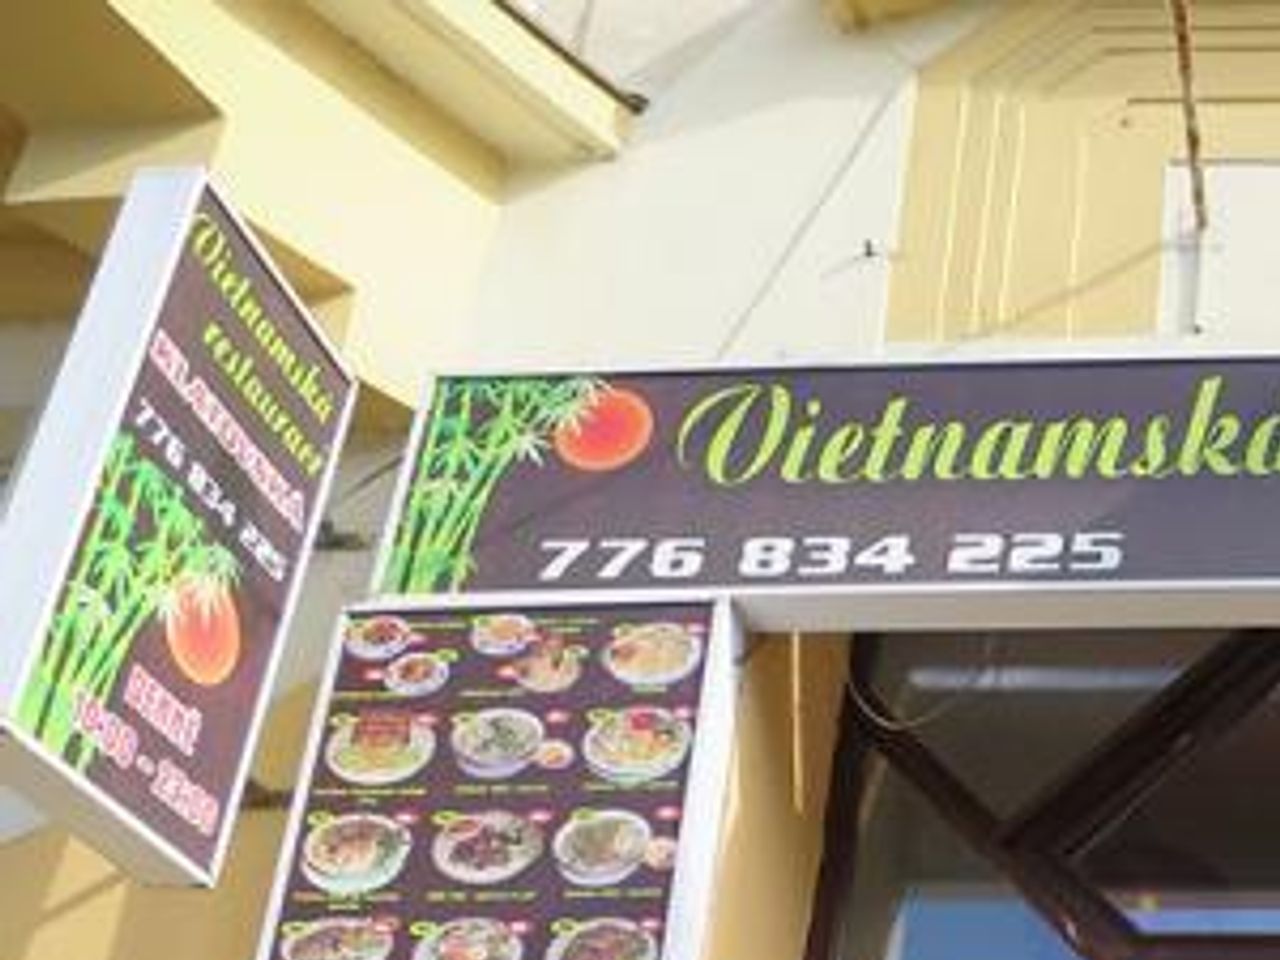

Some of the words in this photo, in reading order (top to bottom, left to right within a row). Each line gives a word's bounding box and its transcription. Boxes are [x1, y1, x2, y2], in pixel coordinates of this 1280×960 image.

[136, 396, 186, 470] 776
[538, 537, 705, 580] 776
[738, 534, 915, 576] 834
[945, 530, 1126, 575] 225
